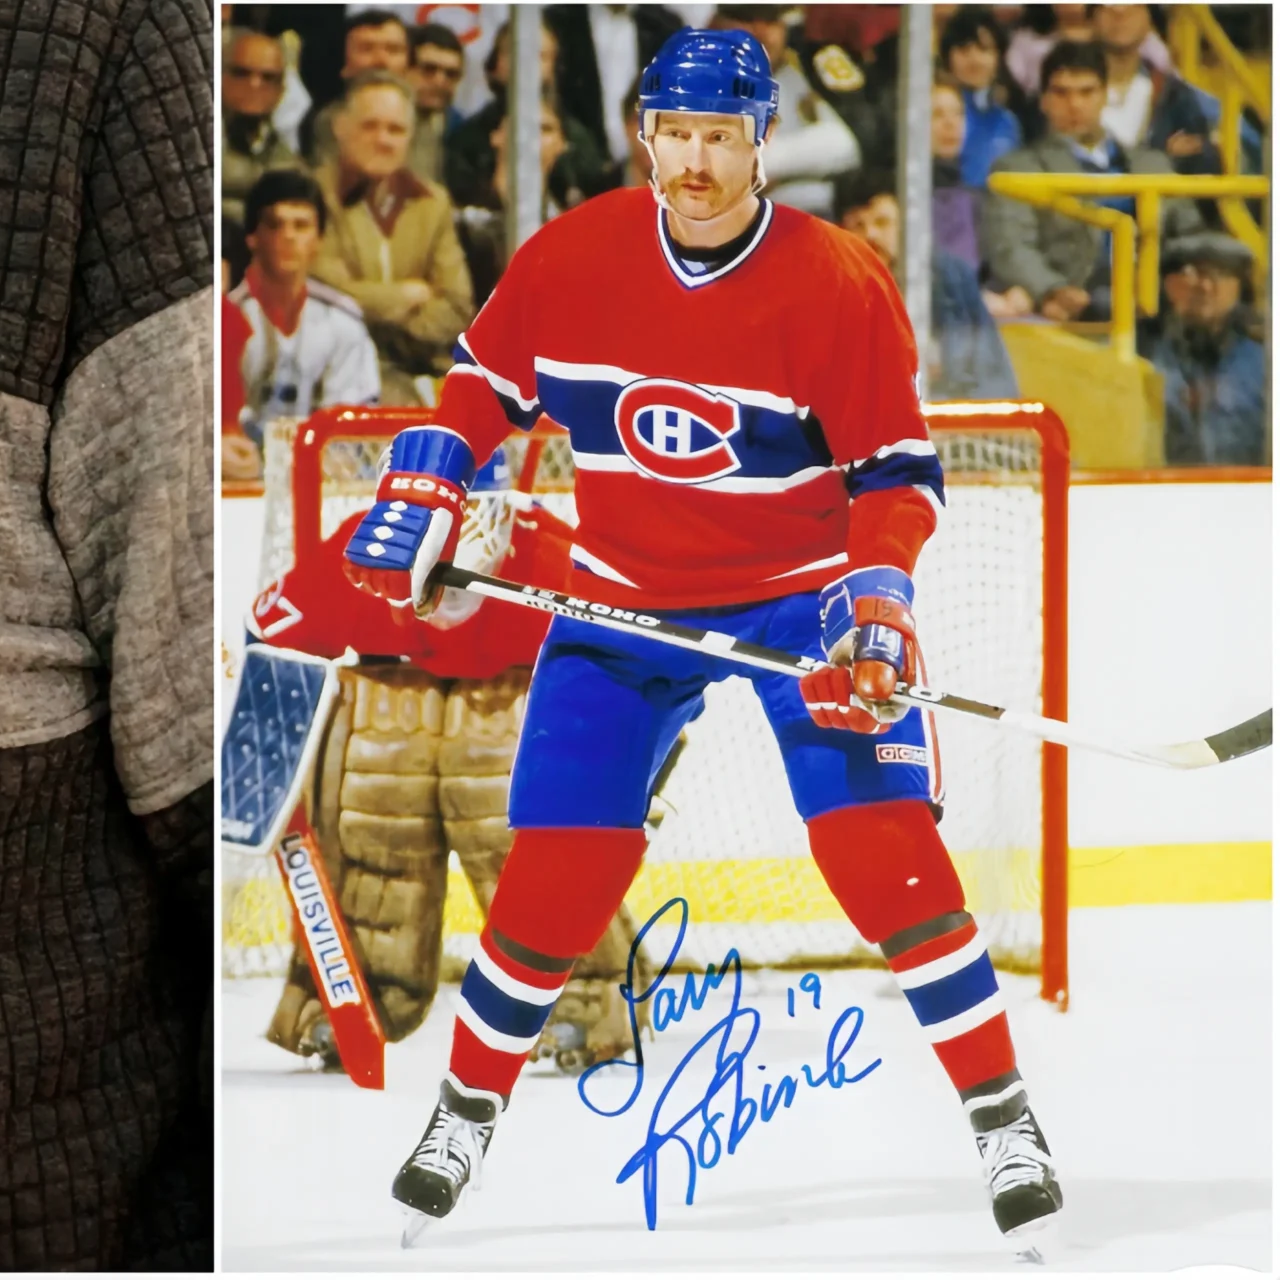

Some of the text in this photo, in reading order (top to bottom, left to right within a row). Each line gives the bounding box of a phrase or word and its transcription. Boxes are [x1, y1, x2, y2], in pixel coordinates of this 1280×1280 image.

[565, 596, 661, 627] KOHO
[280, 833, 355, 1001] LOUISVILLE
[786, 972, 822, 1018] 19
